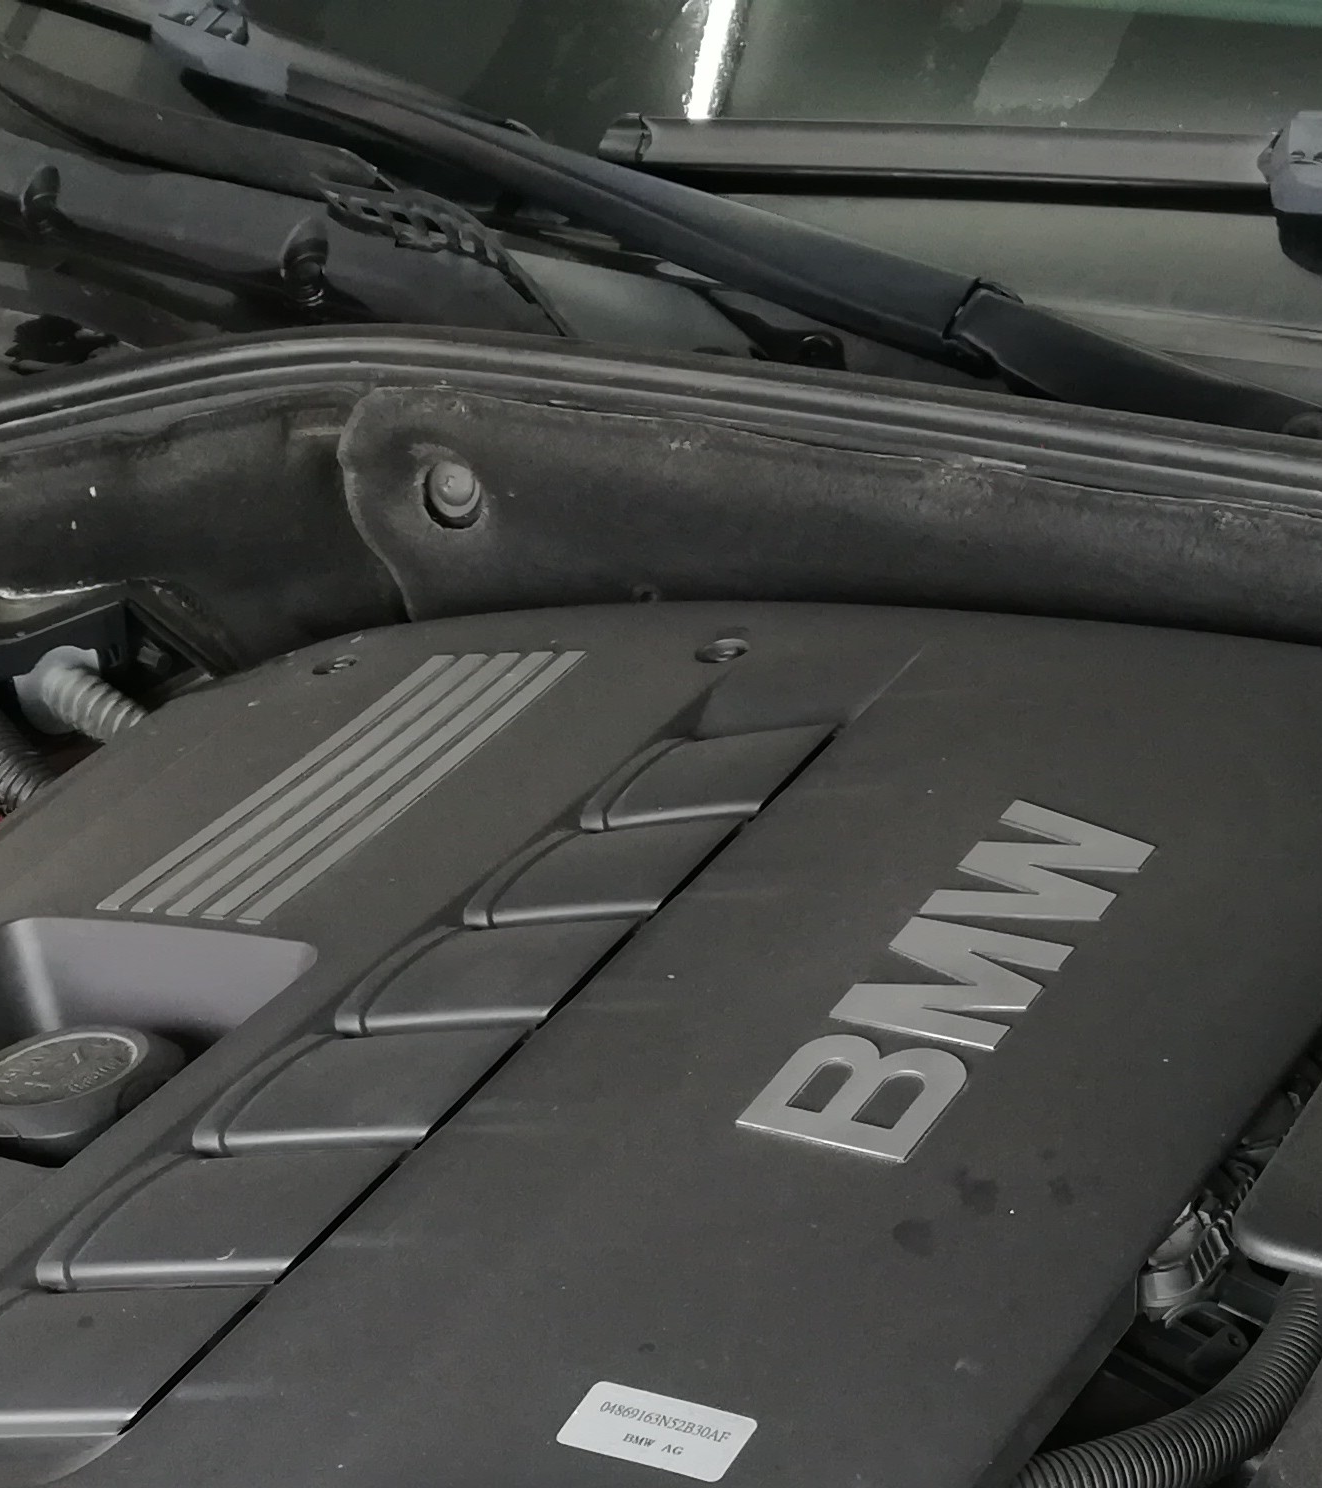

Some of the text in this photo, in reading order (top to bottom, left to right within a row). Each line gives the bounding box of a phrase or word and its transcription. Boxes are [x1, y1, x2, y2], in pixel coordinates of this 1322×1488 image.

[736, 799, 1156, 1162] BMW
[622, 1432, 684, 1456] BMW AG
